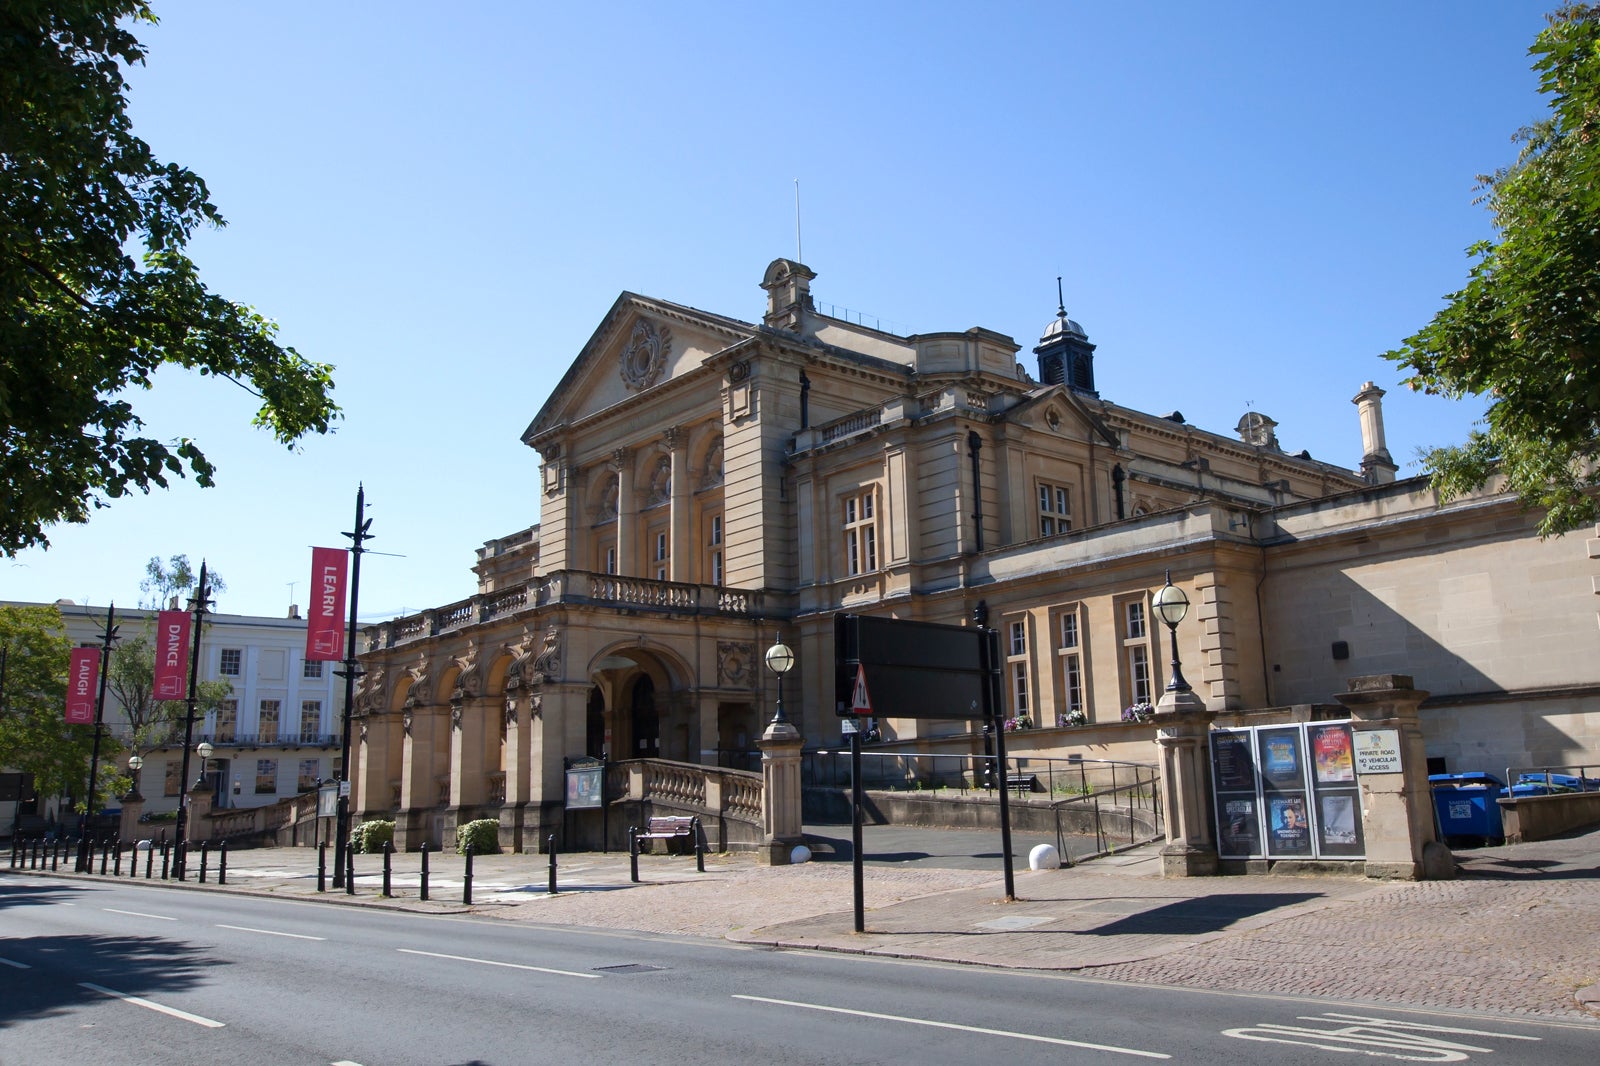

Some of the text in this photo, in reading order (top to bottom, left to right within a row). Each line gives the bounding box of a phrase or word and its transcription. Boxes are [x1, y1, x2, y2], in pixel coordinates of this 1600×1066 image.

[322, 566, 336, 617] LEARN
[166, 624, 181, 667] DANCE
[76, 659, 91, 696] LAUGH
